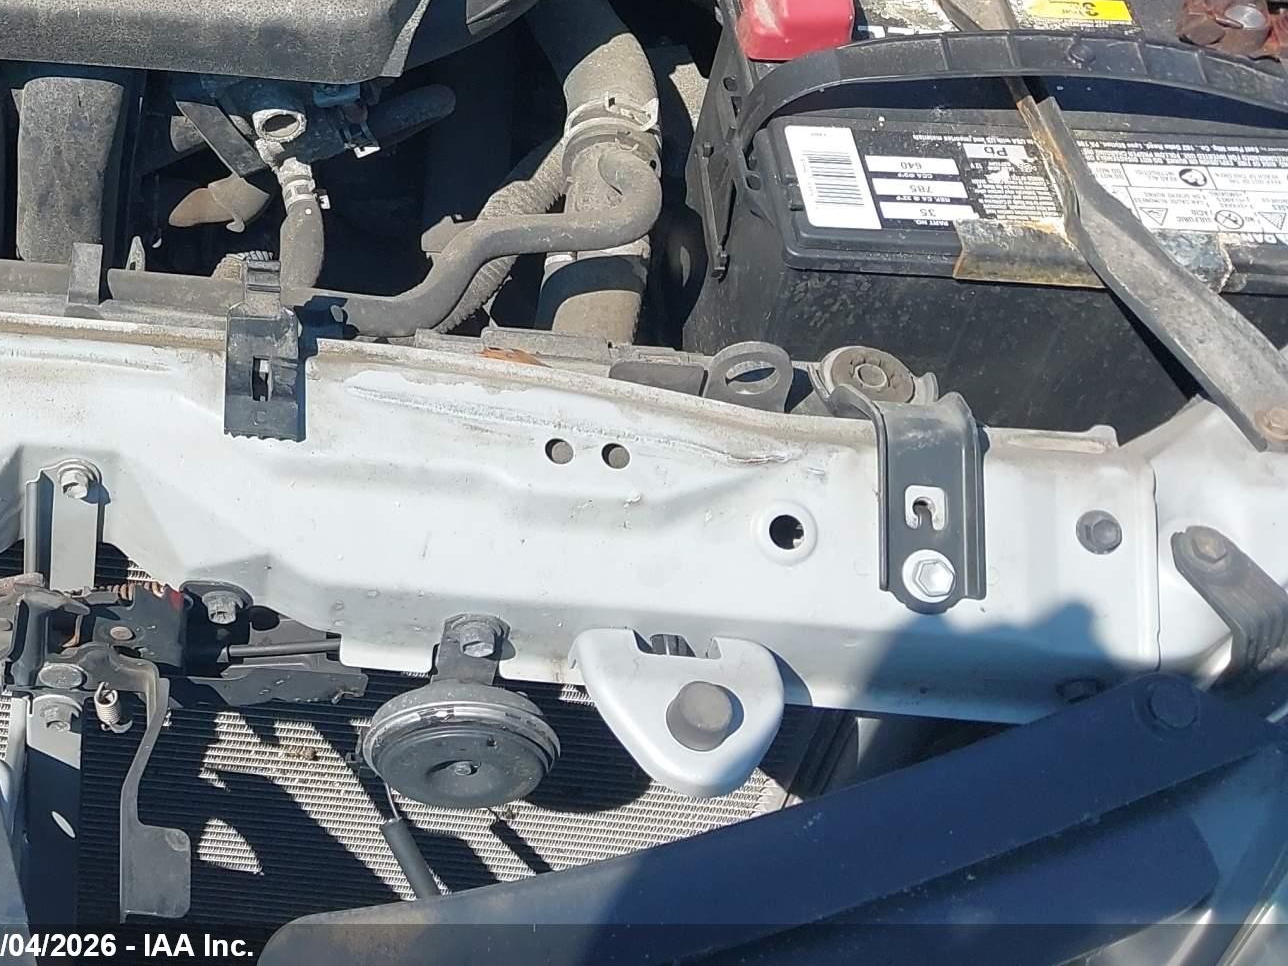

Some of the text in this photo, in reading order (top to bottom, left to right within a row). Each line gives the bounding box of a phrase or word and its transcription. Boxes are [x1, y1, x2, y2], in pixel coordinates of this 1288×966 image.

[983, 146, 1009, 157] Pb
[900, 161, 922, 170] 640
[909, 184, 933, 193] 785
[919, 208, 937, 217] 35
